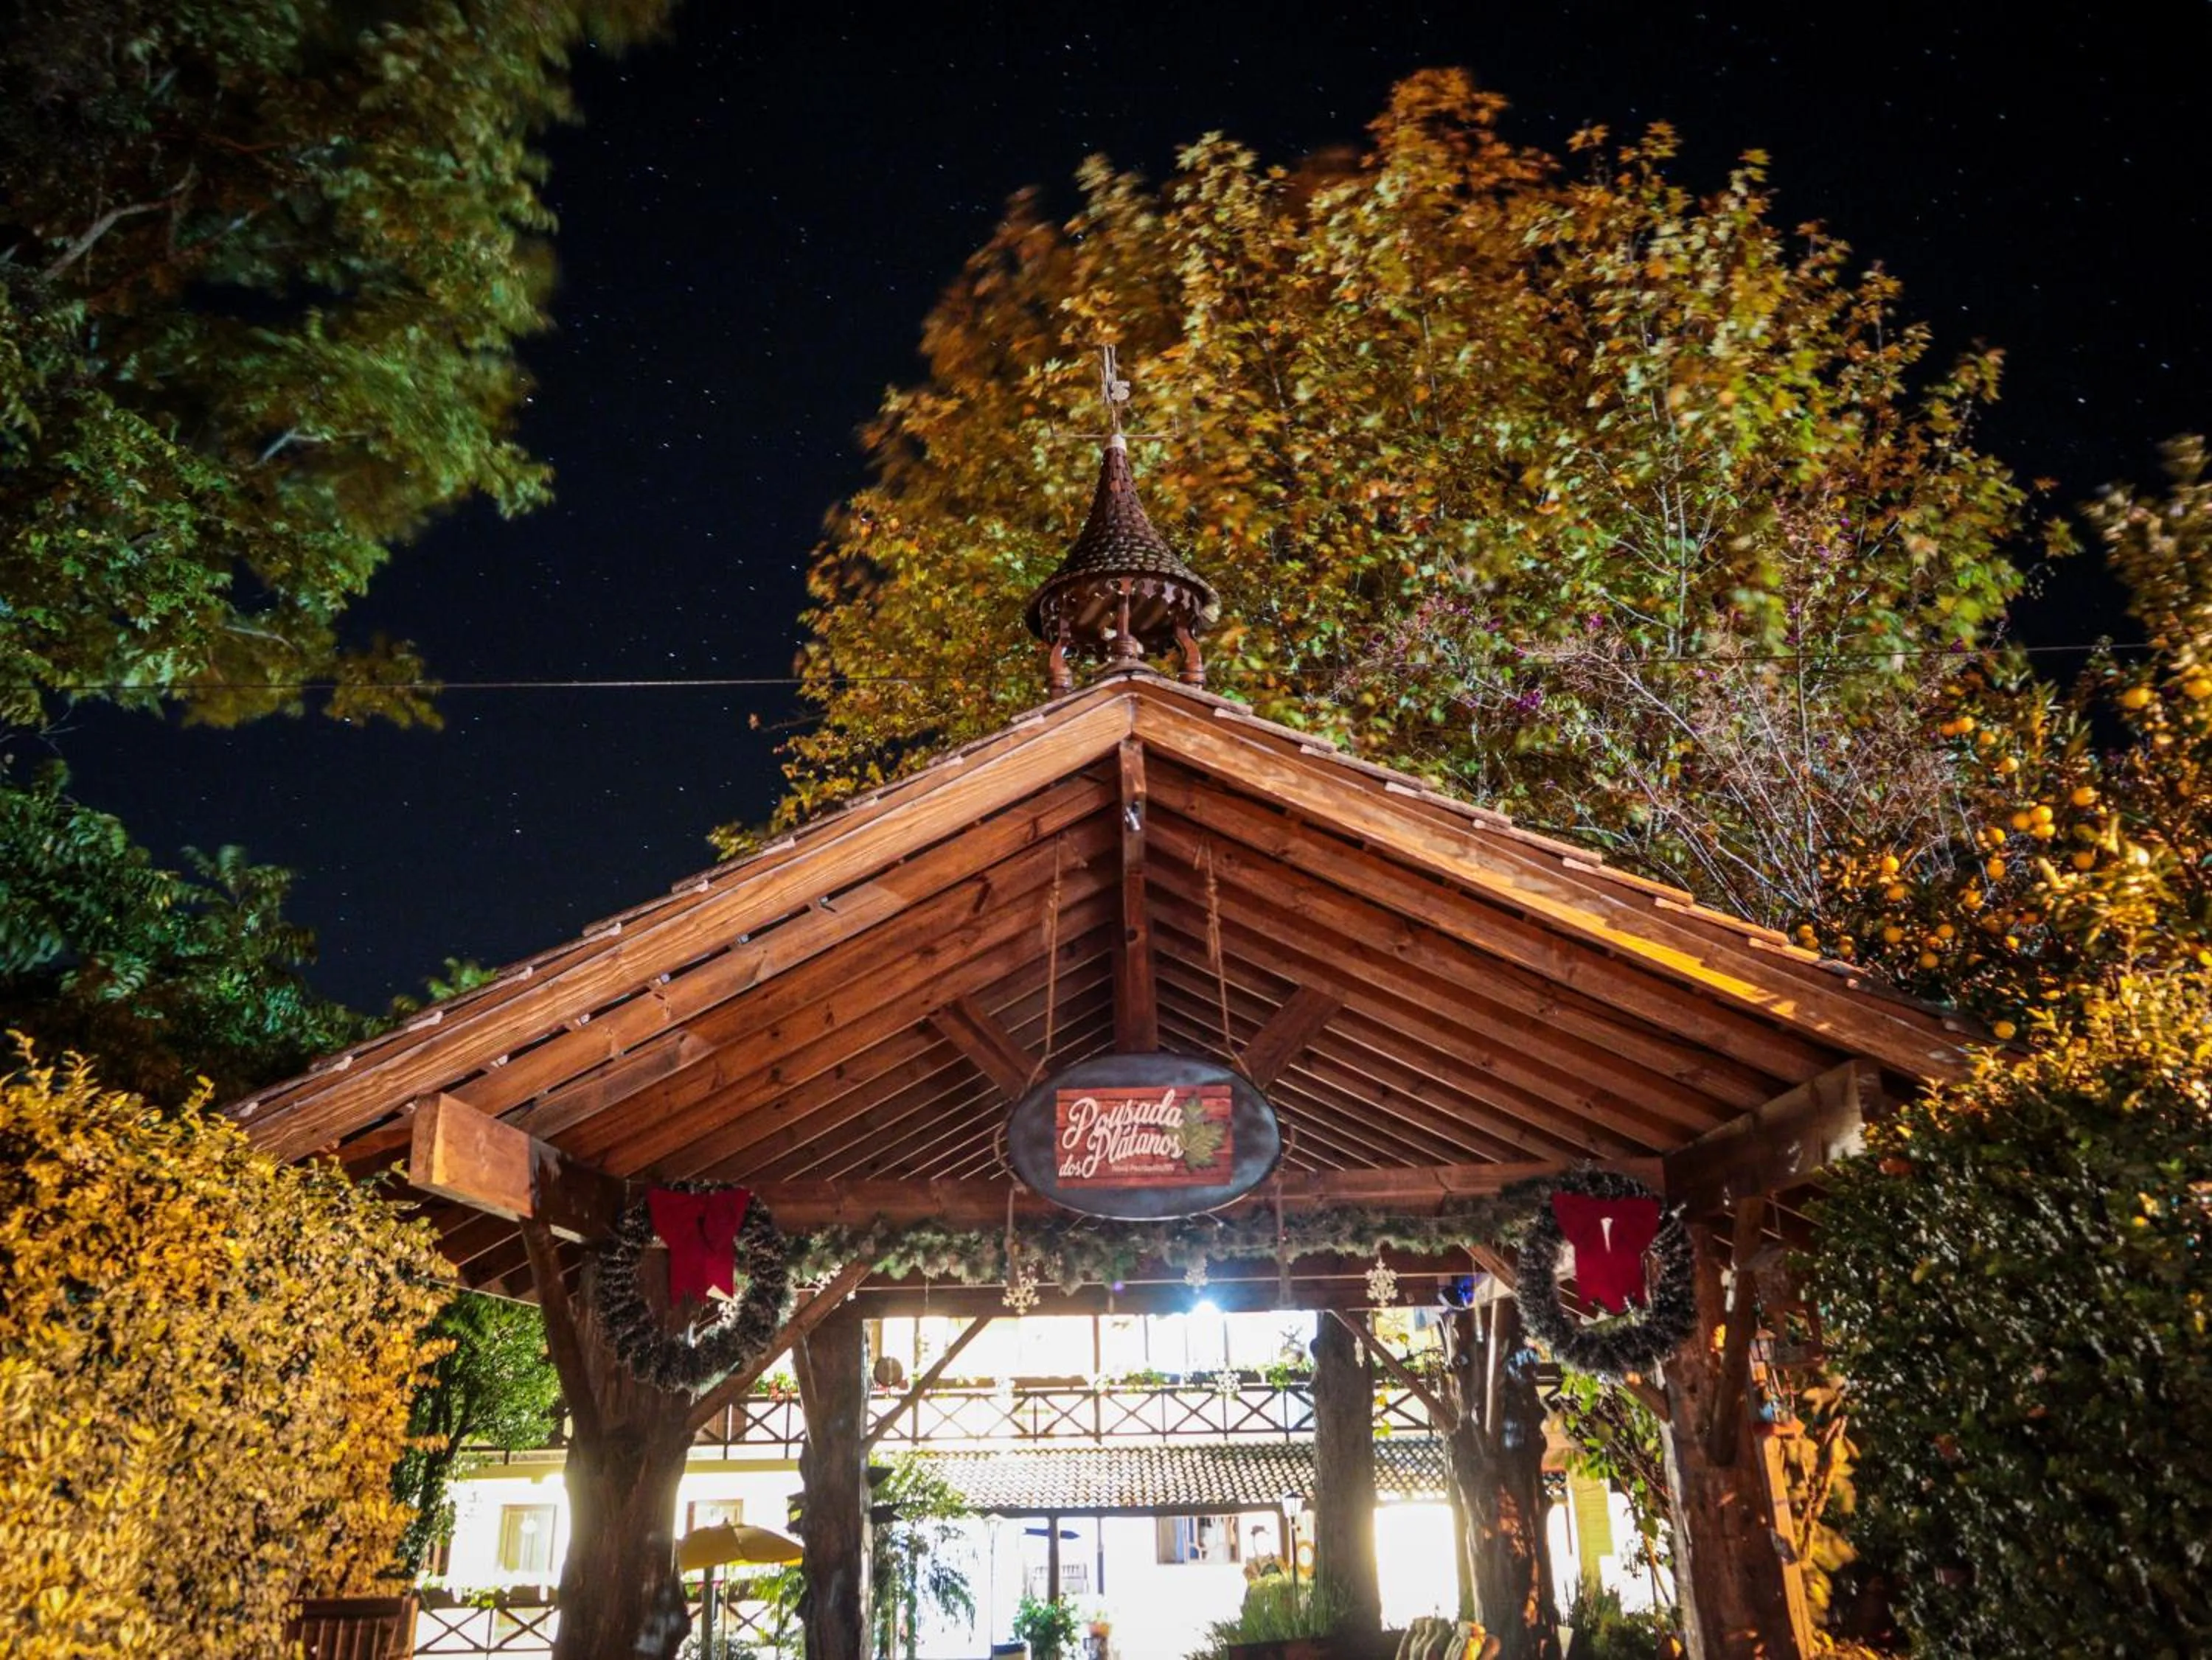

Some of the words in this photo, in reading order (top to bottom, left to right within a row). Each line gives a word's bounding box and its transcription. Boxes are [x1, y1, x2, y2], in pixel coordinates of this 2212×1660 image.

[1062, 1089, 1185, 1150] Pousada
[1059, 1154, 1082, 1177] dos
[1082, 1123, 1184, 1179] Plátanos
